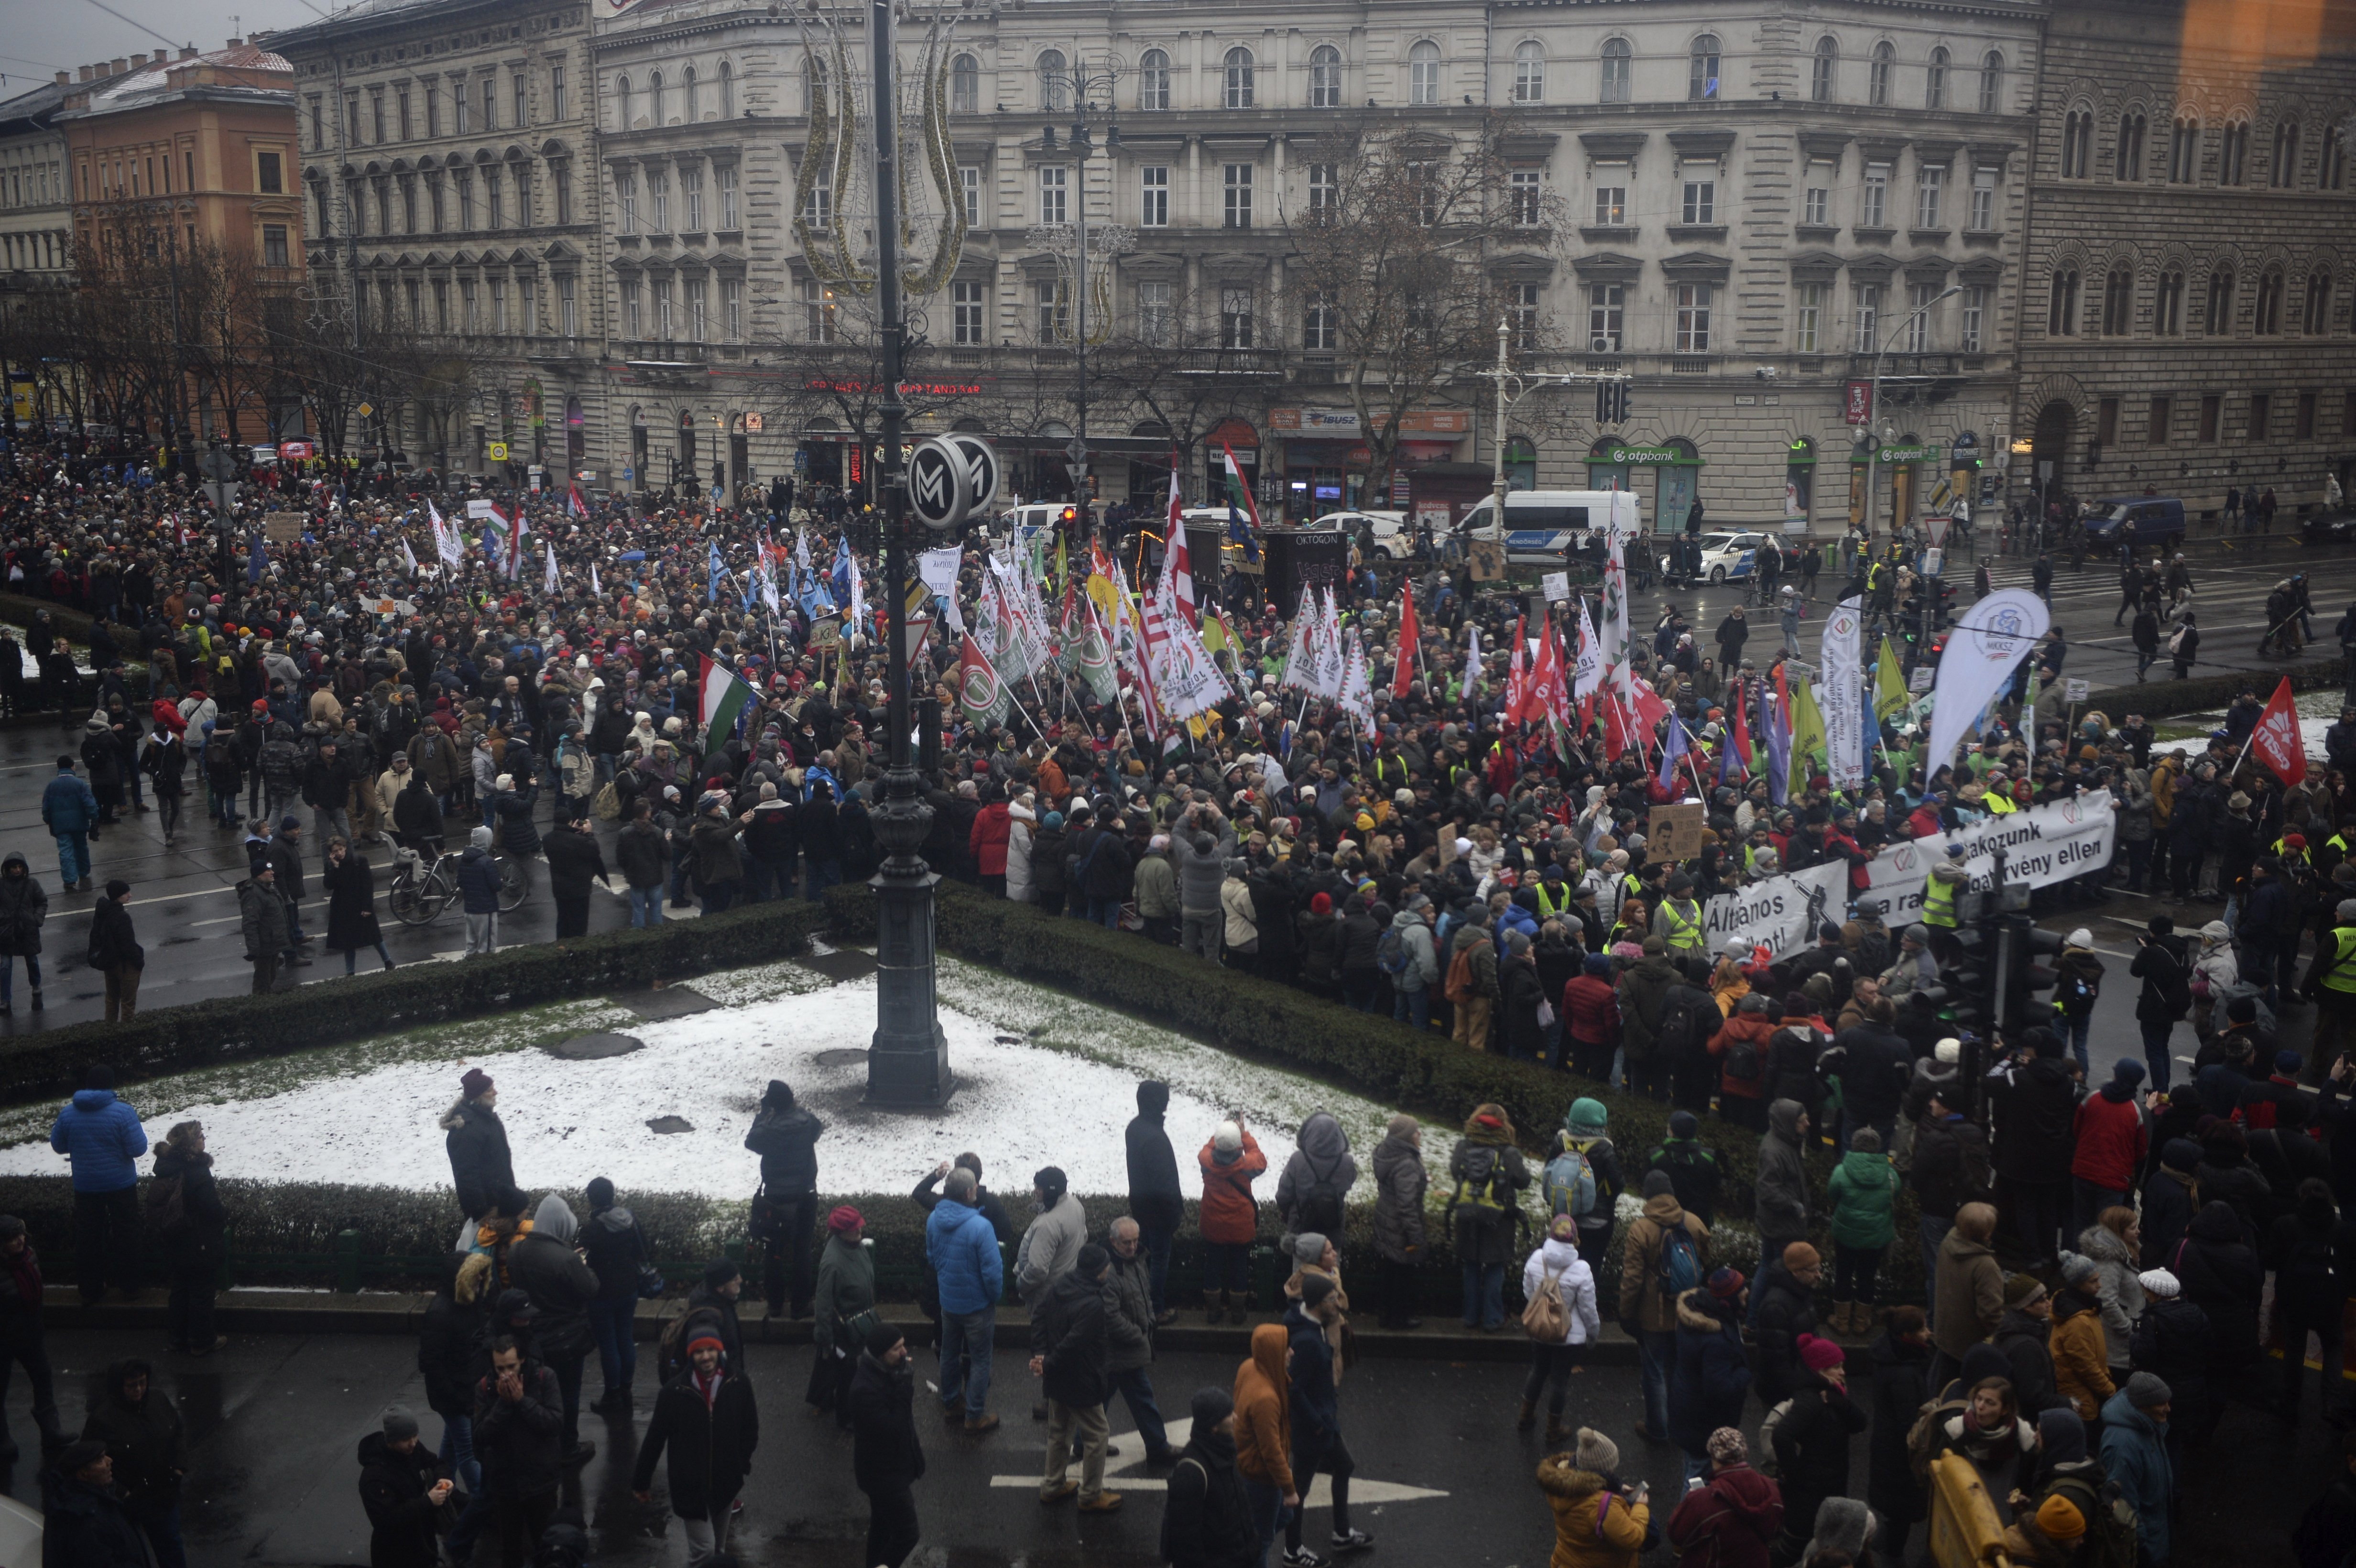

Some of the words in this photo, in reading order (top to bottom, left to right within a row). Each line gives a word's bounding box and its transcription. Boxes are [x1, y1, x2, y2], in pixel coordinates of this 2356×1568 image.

[933, 384, 956, 393] AND
[1323, 416, 1356, 425] IBUSZ
[1628, 450, 1674, 463] otpbank
[916, 460, 945, 509] M
[1296, 534, 1338, 545] OKTOGON
[1987, 640, 2014, 652] MKKSZ
[1878, 899, 1890, 914] a
[2058, 839, 2101, 865] ellen
